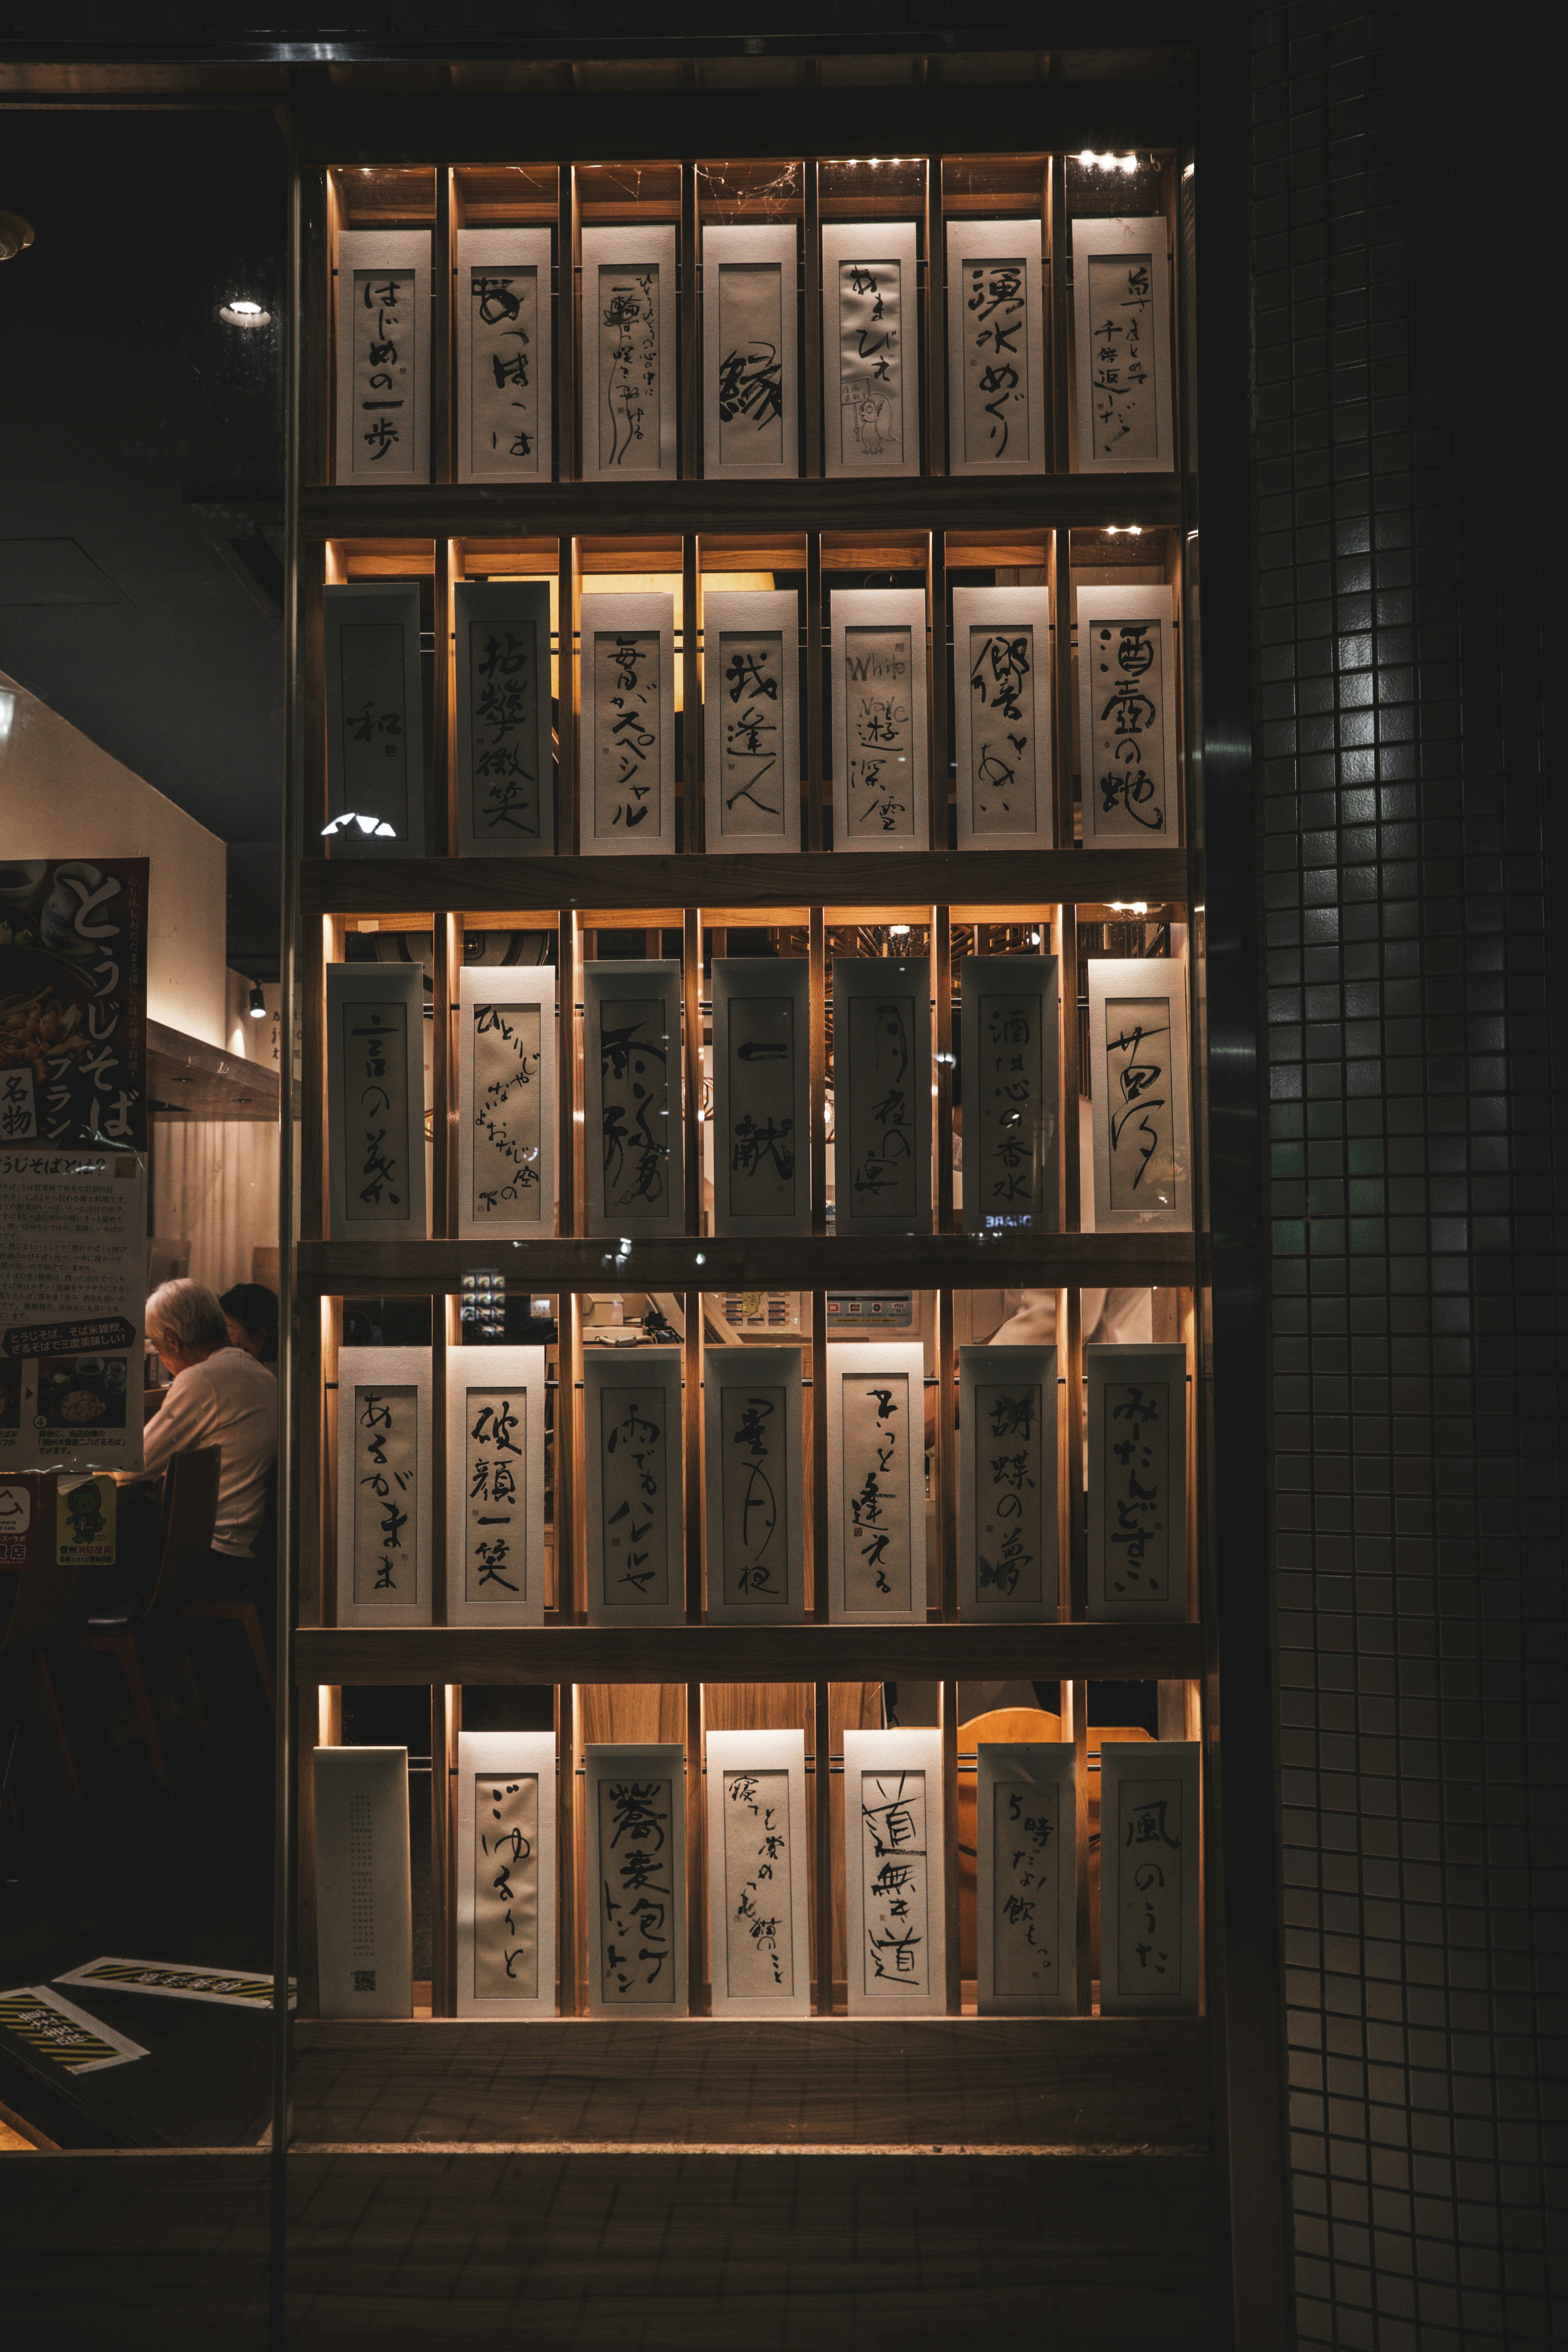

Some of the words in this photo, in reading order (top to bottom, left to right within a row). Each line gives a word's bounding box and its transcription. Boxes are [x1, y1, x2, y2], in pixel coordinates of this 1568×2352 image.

[362, 281, 404, 461] はじめの一歩
[968, 268, 1025, 457] 湧水めぐり
[346, 701, 402, 742] 和
[607, 635, 657, 828] 毎日がスペシャル
[847, 653, 906, 681] White
[62, 876, 139, 1137] とうじそば
[0, 1156, 105, 1176] うじそばとは？
[2, 1076, 32, 1136] 名物
[46, 1052, 75, 1140] プラン
[351, 1014, 400, 1205] 言の葉
[987, 1009, 1033, 1202] 酒は心の香水
[0, 1213, 122, 1223] そばをしゃぶしゃぶの様にさっと温めて
[0, 1243, 127, 1253] に投じるということで「投汁そば」と呼び
[12, 1334, 126, 1354] ざるそばで三度美味しい！
[60, 1545, 111, 1554] 信州消防団員
[359, 1392, 413, 1590] あるがまま
[469, 1401, 522, 1592] 破顔一笑
[607, 1404, 660, 1593] 雨でもハレルヤ
[987, 1398, 1035, 1596] 胡蝶の夢
[862, 1771, 927, 1986] 道無き道
[1125, 1800, 1180, 1974] 風のうた
[18, 2009, 88, 2045] 段差注意
